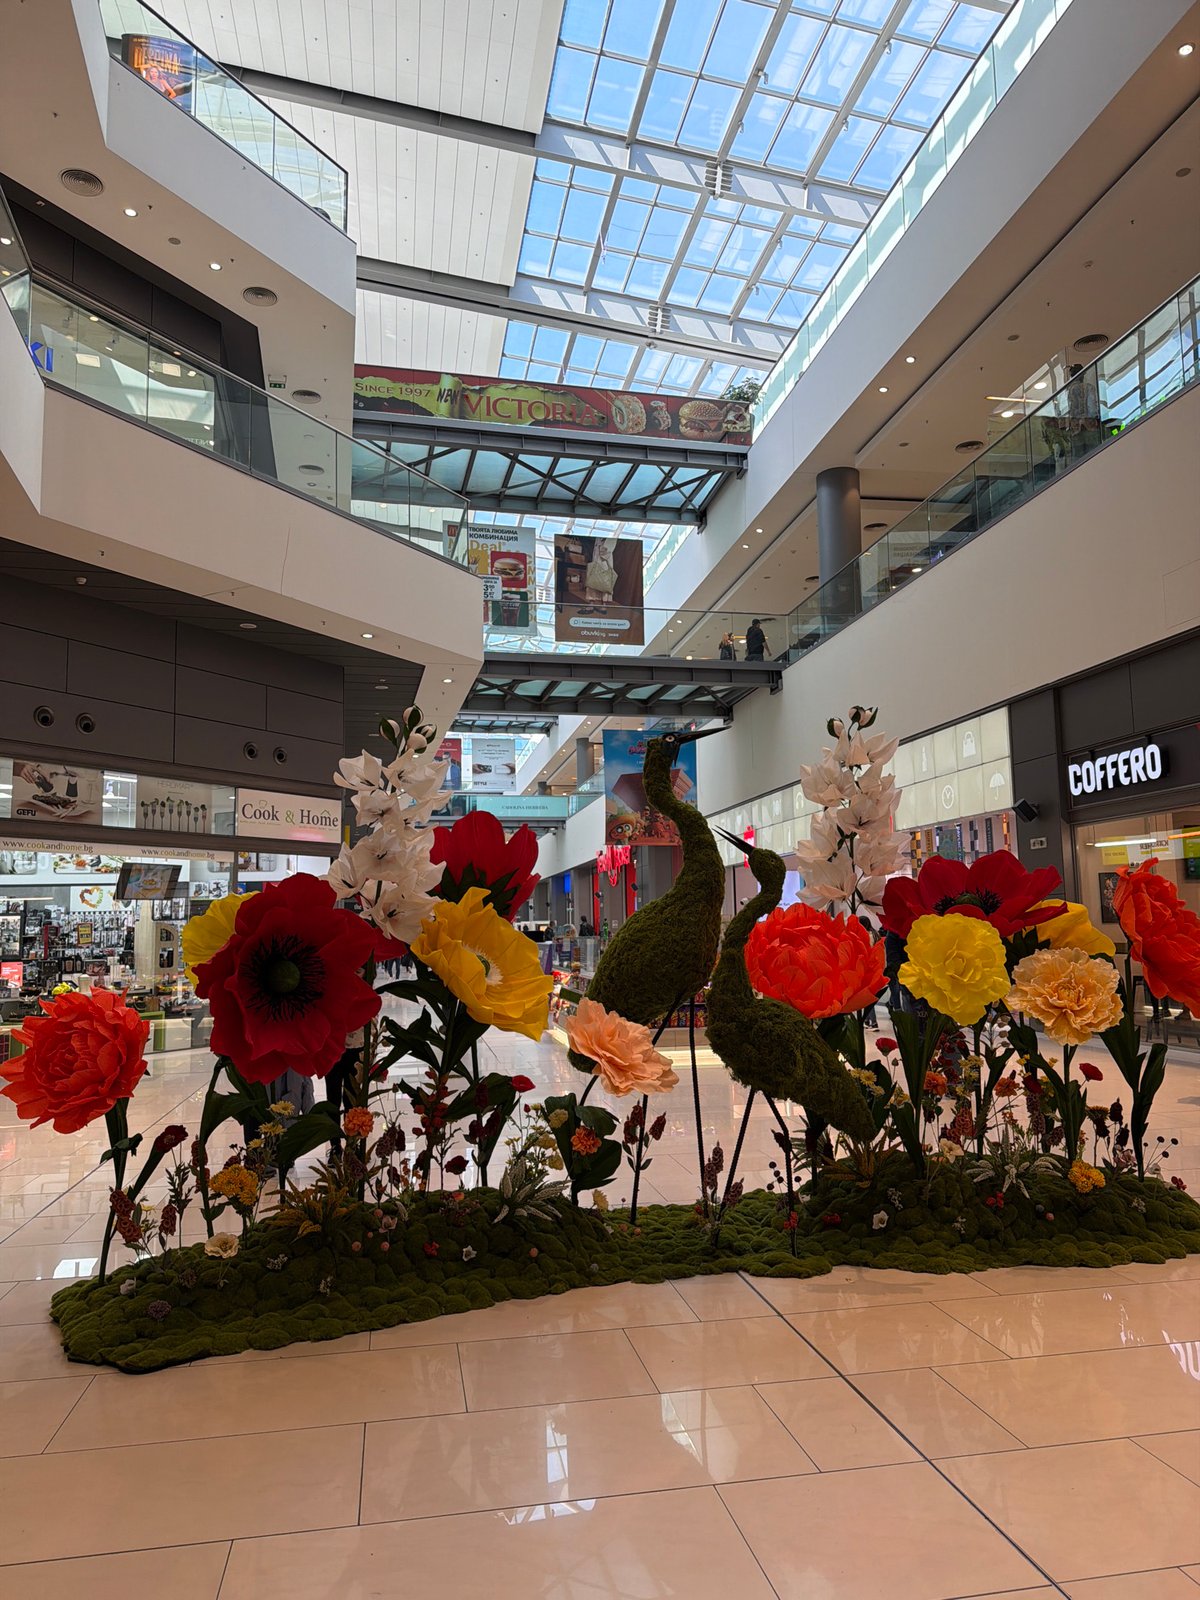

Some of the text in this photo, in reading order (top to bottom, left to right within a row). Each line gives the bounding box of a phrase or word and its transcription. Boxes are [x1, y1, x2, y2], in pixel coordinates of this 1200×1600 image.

[355, 382, 431, 398] SINCE 1997
[463, 393, 597, 426] VICTORIA
[469, 533, 519, 542] КОМБИНАЦИЯ
[1068, 744, 1161, 796] COFFERO
[16, 808, 37, 817] GEFU
[241, 803, 339, 828] Cook & Home
[3, 840, 94, 853] www.cookandhome.bg
[141, 848, 216, 860] www.cookandhome.bg
